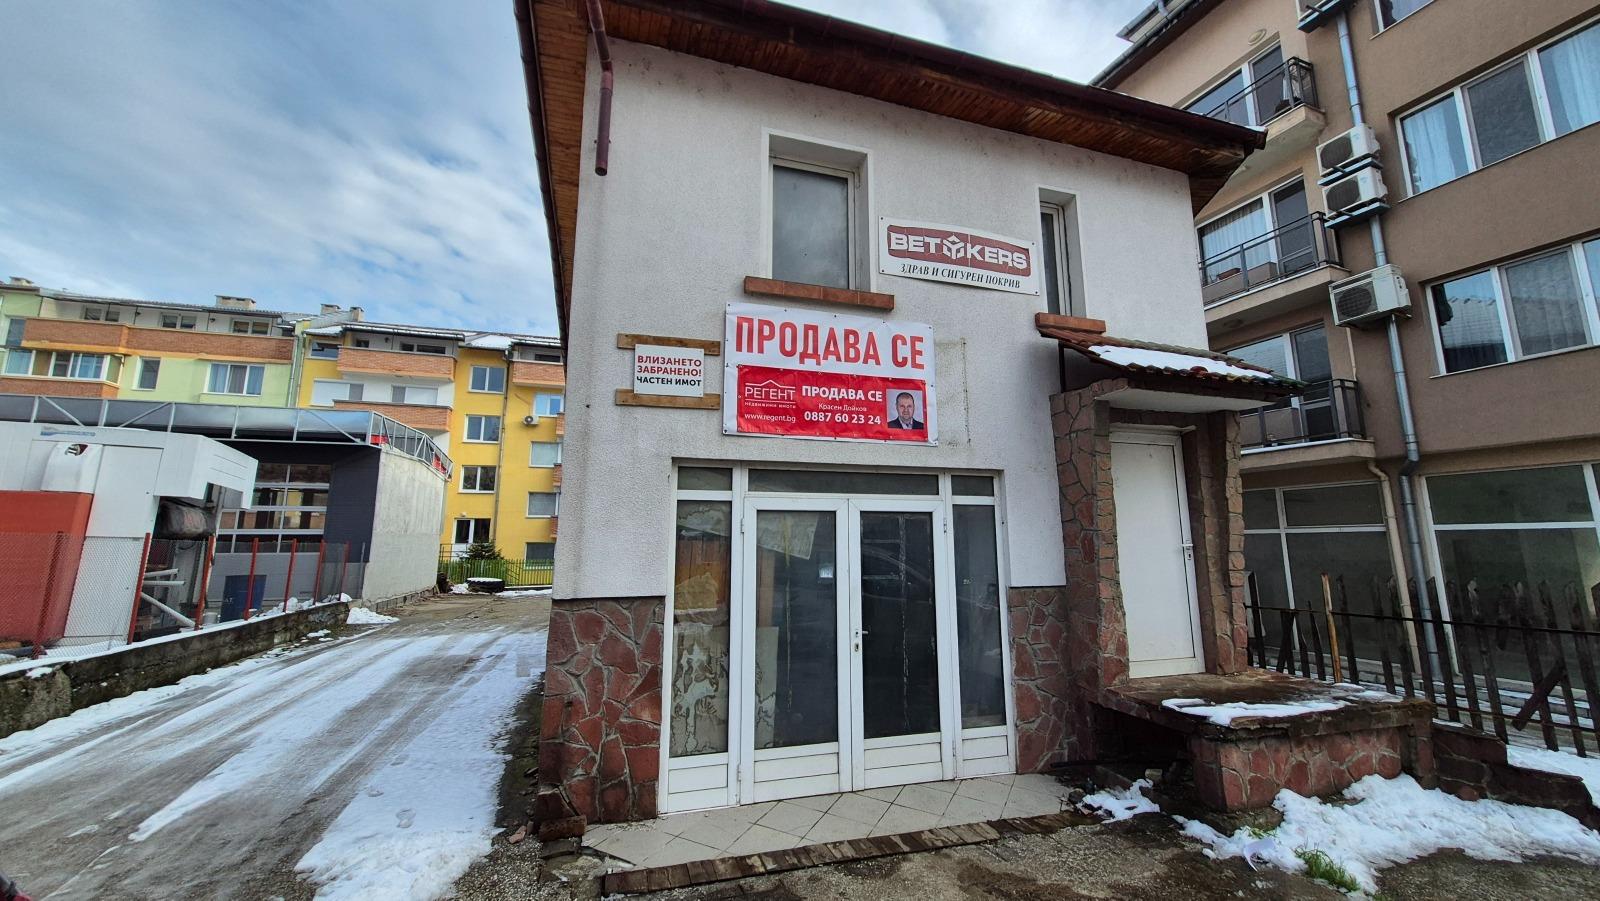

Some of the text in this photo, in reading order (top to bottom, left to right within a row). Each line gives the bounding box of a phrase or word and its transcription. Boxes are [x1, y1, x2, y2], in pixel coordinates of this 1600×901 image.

[900, 263, 1020, 289] ЗДРАВ И СИГУРЕН ПОКРИВ
[736, 316, 925, 370] ПРОДАВА СЕ
[637, 355, 702, 367] ВЛИЗАНЕТО
[637, 365, 702, 377] ЗАБРАНЕНО!
[636, 376, 702, 387] ЧАСТЕН ИМОТ
[745, 386, 796, 401] РЕГЕНТ
[801, 386, 883, 402] ПРОДАВА СЕ
[818, 403, 842, 411] Красен
[744, 413, 796, 423] www.regent.bg
[804, 411, 882, 425] 0887 60 23 24
